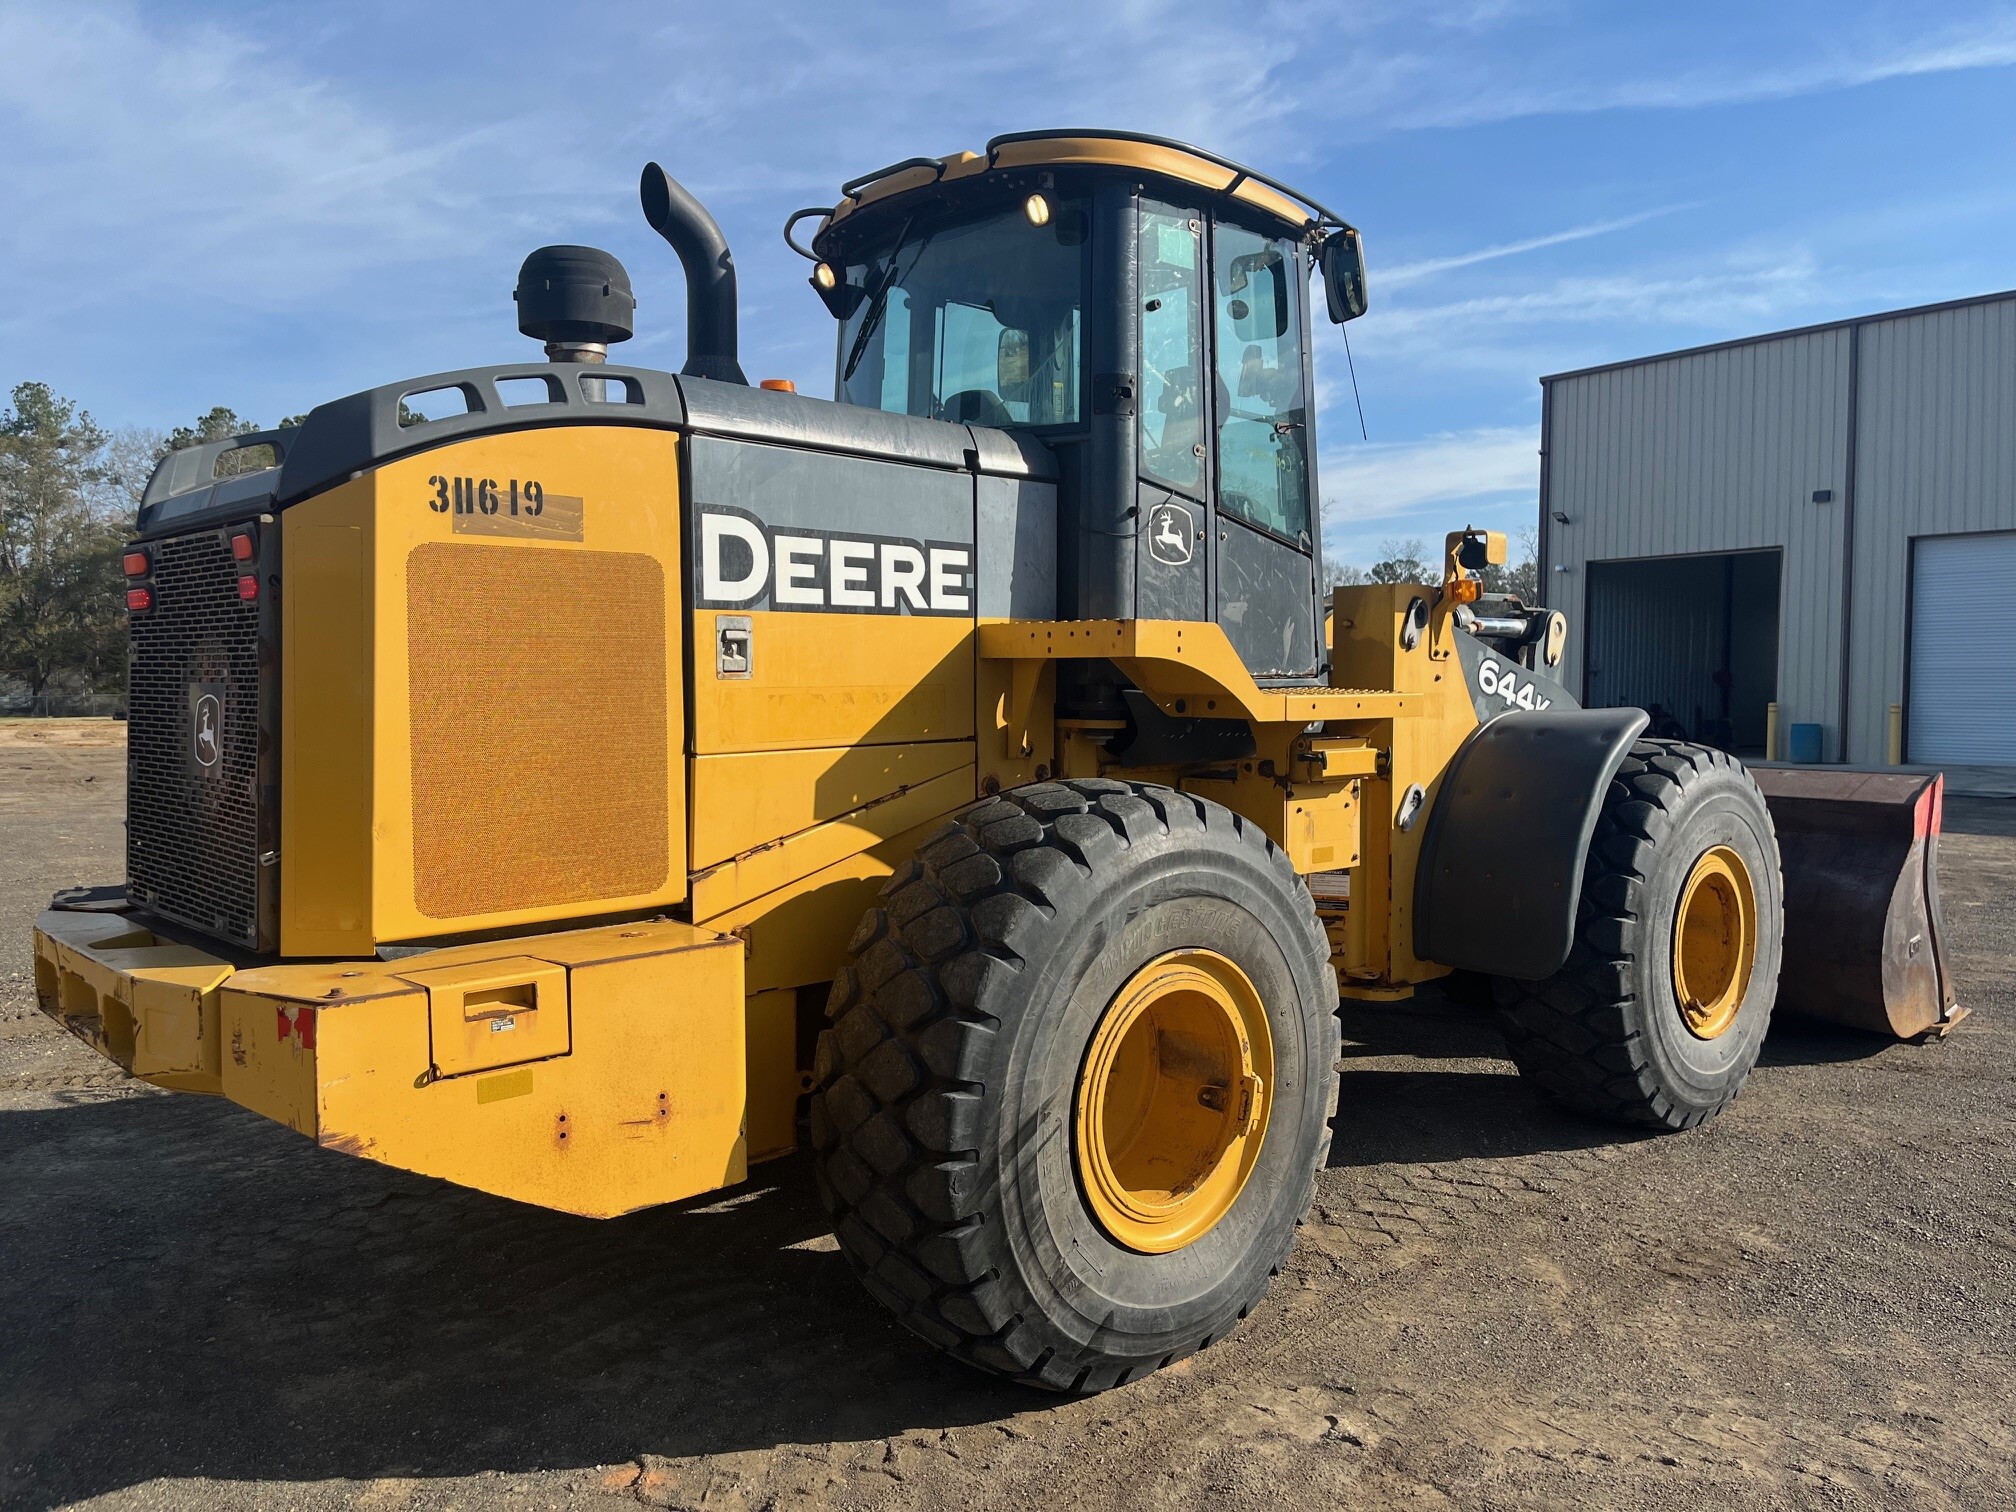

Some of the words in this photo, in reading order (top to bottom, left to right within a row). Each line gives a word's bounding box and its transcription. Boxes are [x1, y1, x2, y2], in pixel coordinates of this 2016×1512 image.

[428, 475, 544, 516] 311619
[701, 512, 969, 610] DEERE
[1100, 908, 1241, 977] BRIDGESTONE
